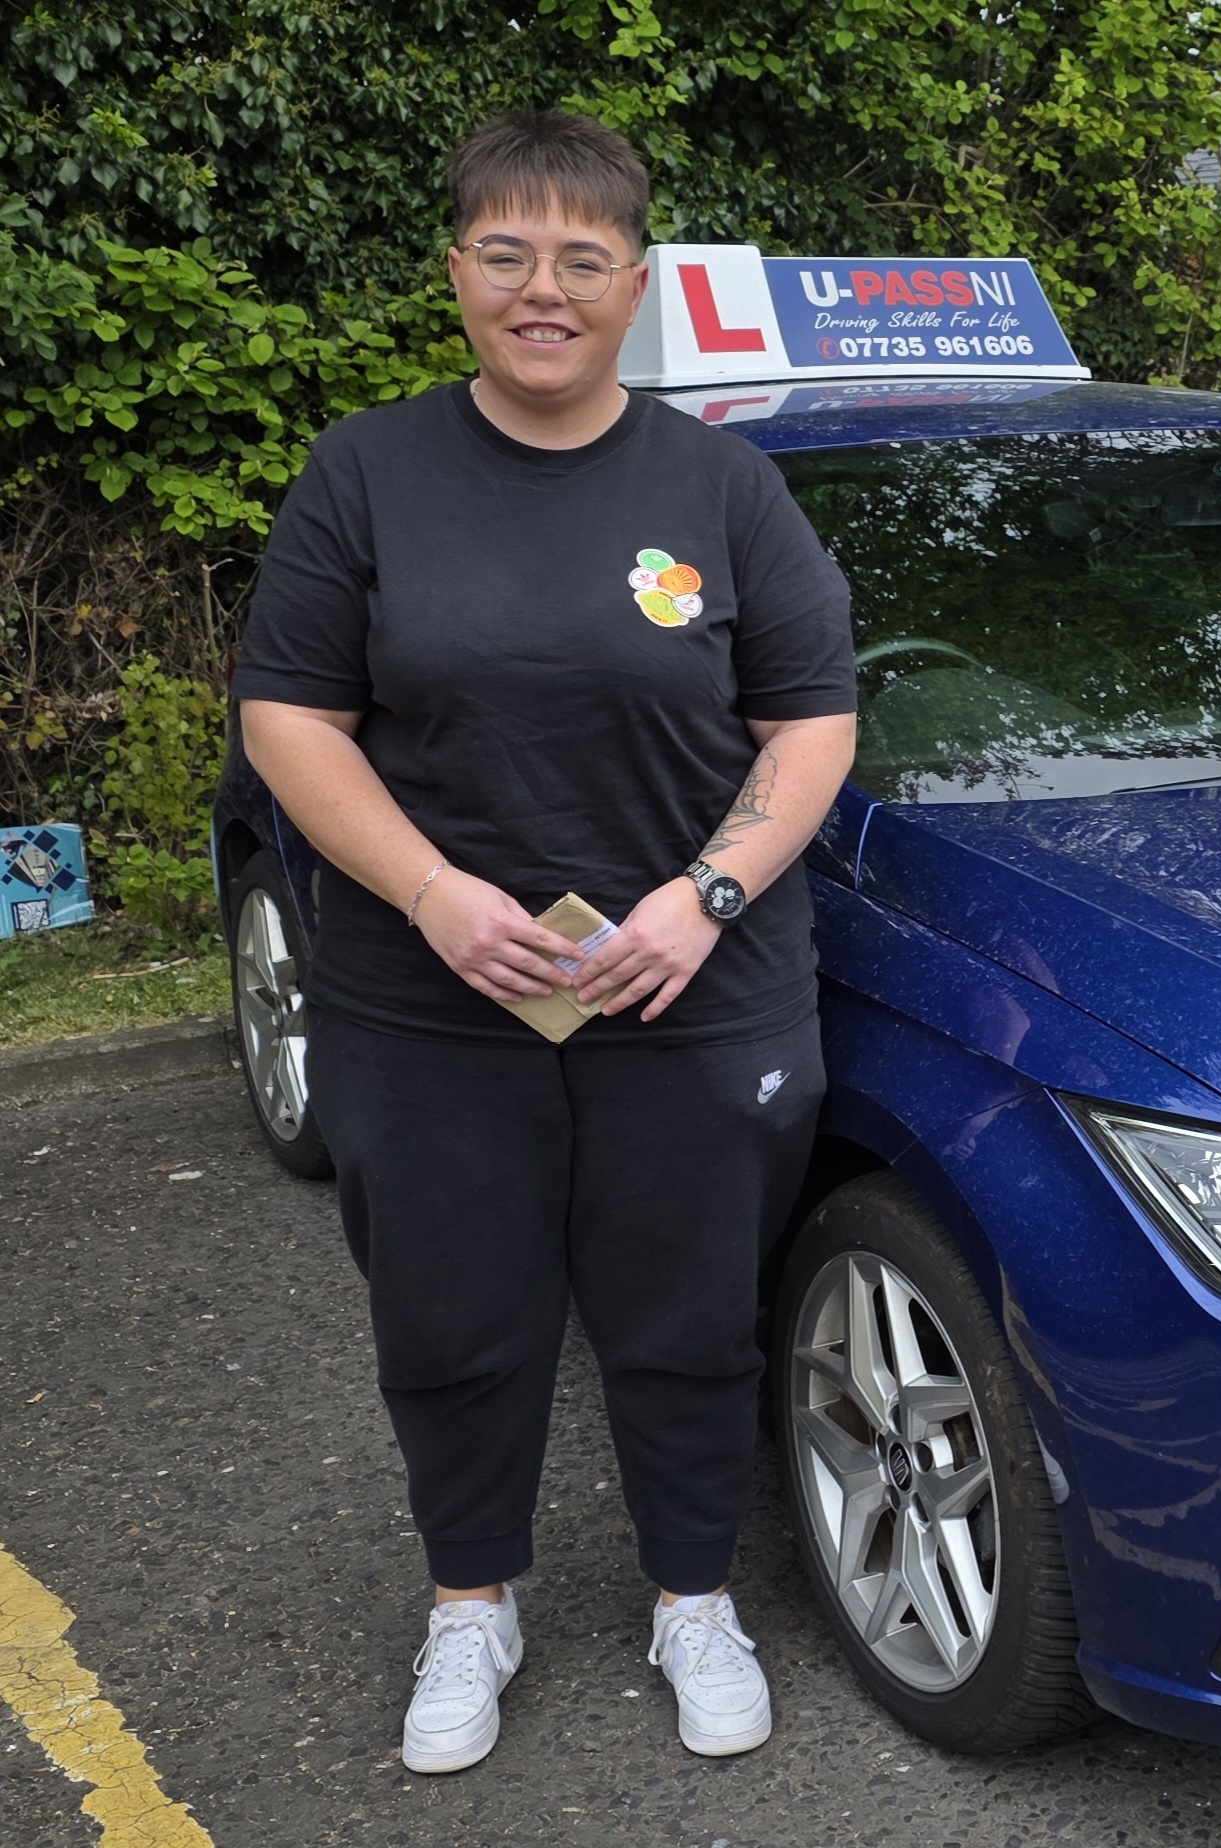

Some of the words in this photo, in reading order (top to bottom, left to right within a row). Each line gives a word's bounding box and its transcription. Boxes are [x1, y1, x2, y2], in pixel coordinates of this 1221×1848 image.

[676, 263, 767, 353] L
[814, 311, 880, 333] Driving
[887, 310, 943, 328] Skills
[949, 310, 981, 328] For
[987, 311, 1021, 332] Life
[839, 336, 927, 358] 07735
[934, 335, 1034, 357] 961606
[760, 1069, 782, 1094] NIKE
